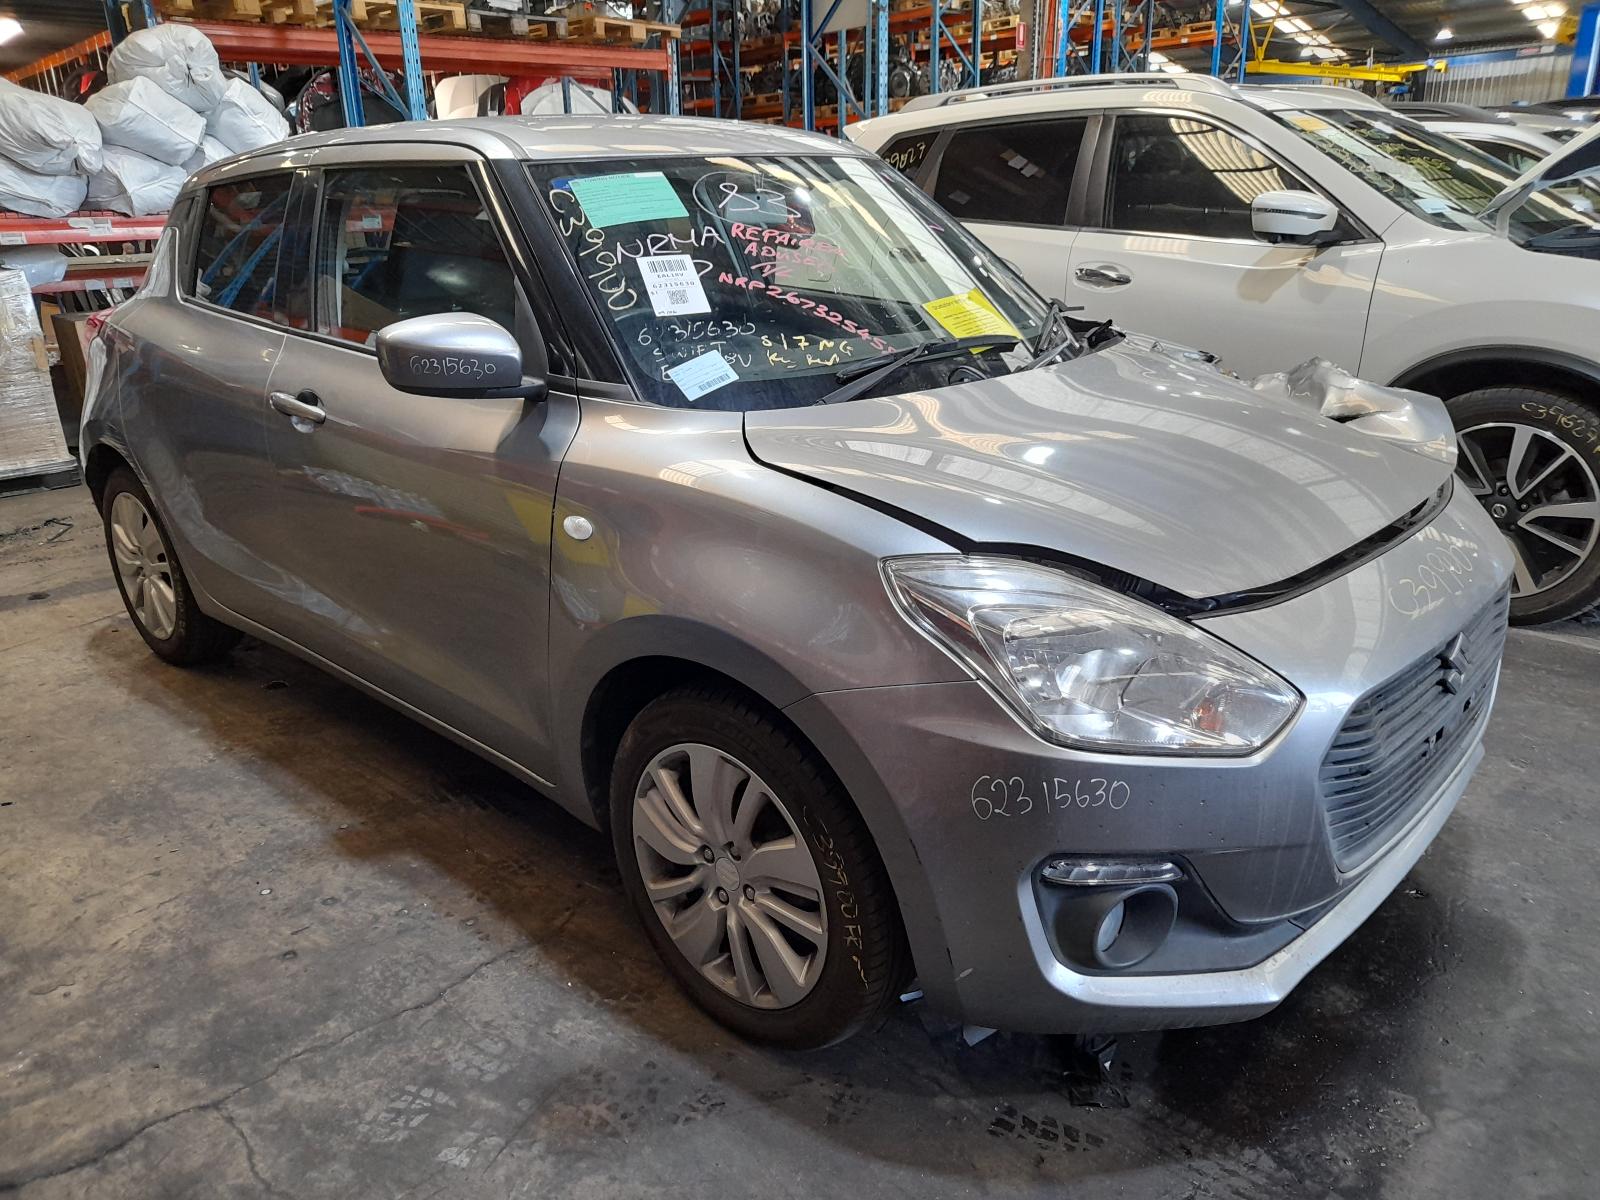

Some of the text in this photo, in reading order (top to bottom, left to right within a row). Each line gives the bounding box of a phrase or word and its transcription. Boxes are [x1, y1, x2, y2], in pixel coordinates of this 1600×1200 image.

[617, 226, 726, 264] NRMA
[638, 320, 756, 346] 6315630
[410, 355, 496, 380] 62315630
[971, 775, 1131, 820] 62315630
